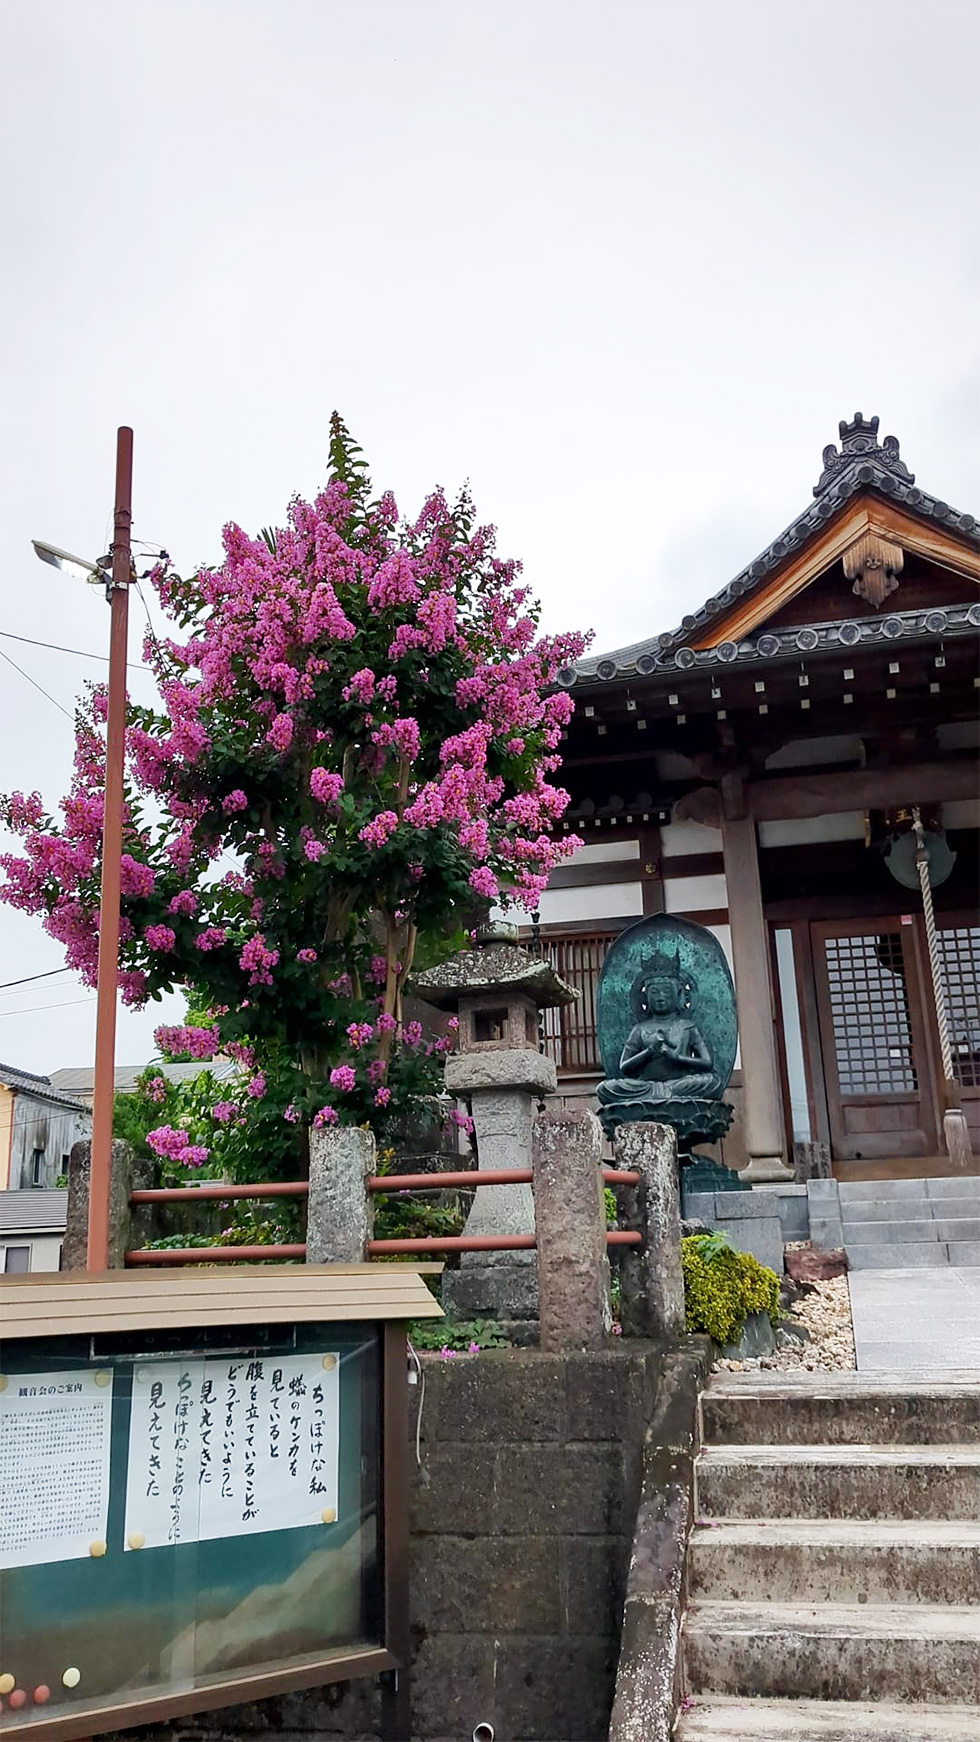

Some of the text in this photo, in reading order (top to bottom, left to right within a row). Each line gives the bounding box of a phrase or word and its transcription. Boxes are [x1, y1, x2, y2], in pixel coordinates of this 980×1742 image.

[146, 1381, 166, 1497] 見えてきた
[198, 1379, 217, 1485] 見えてきた
[221, 1364, 244, 1498] どうでもいいように
[242, 1361, 264, 1521] 腹を立てていることが
[269, 1369, 285, 1458] 見ていると
[309, 1383, 327, 1495] ちっぽけな私
